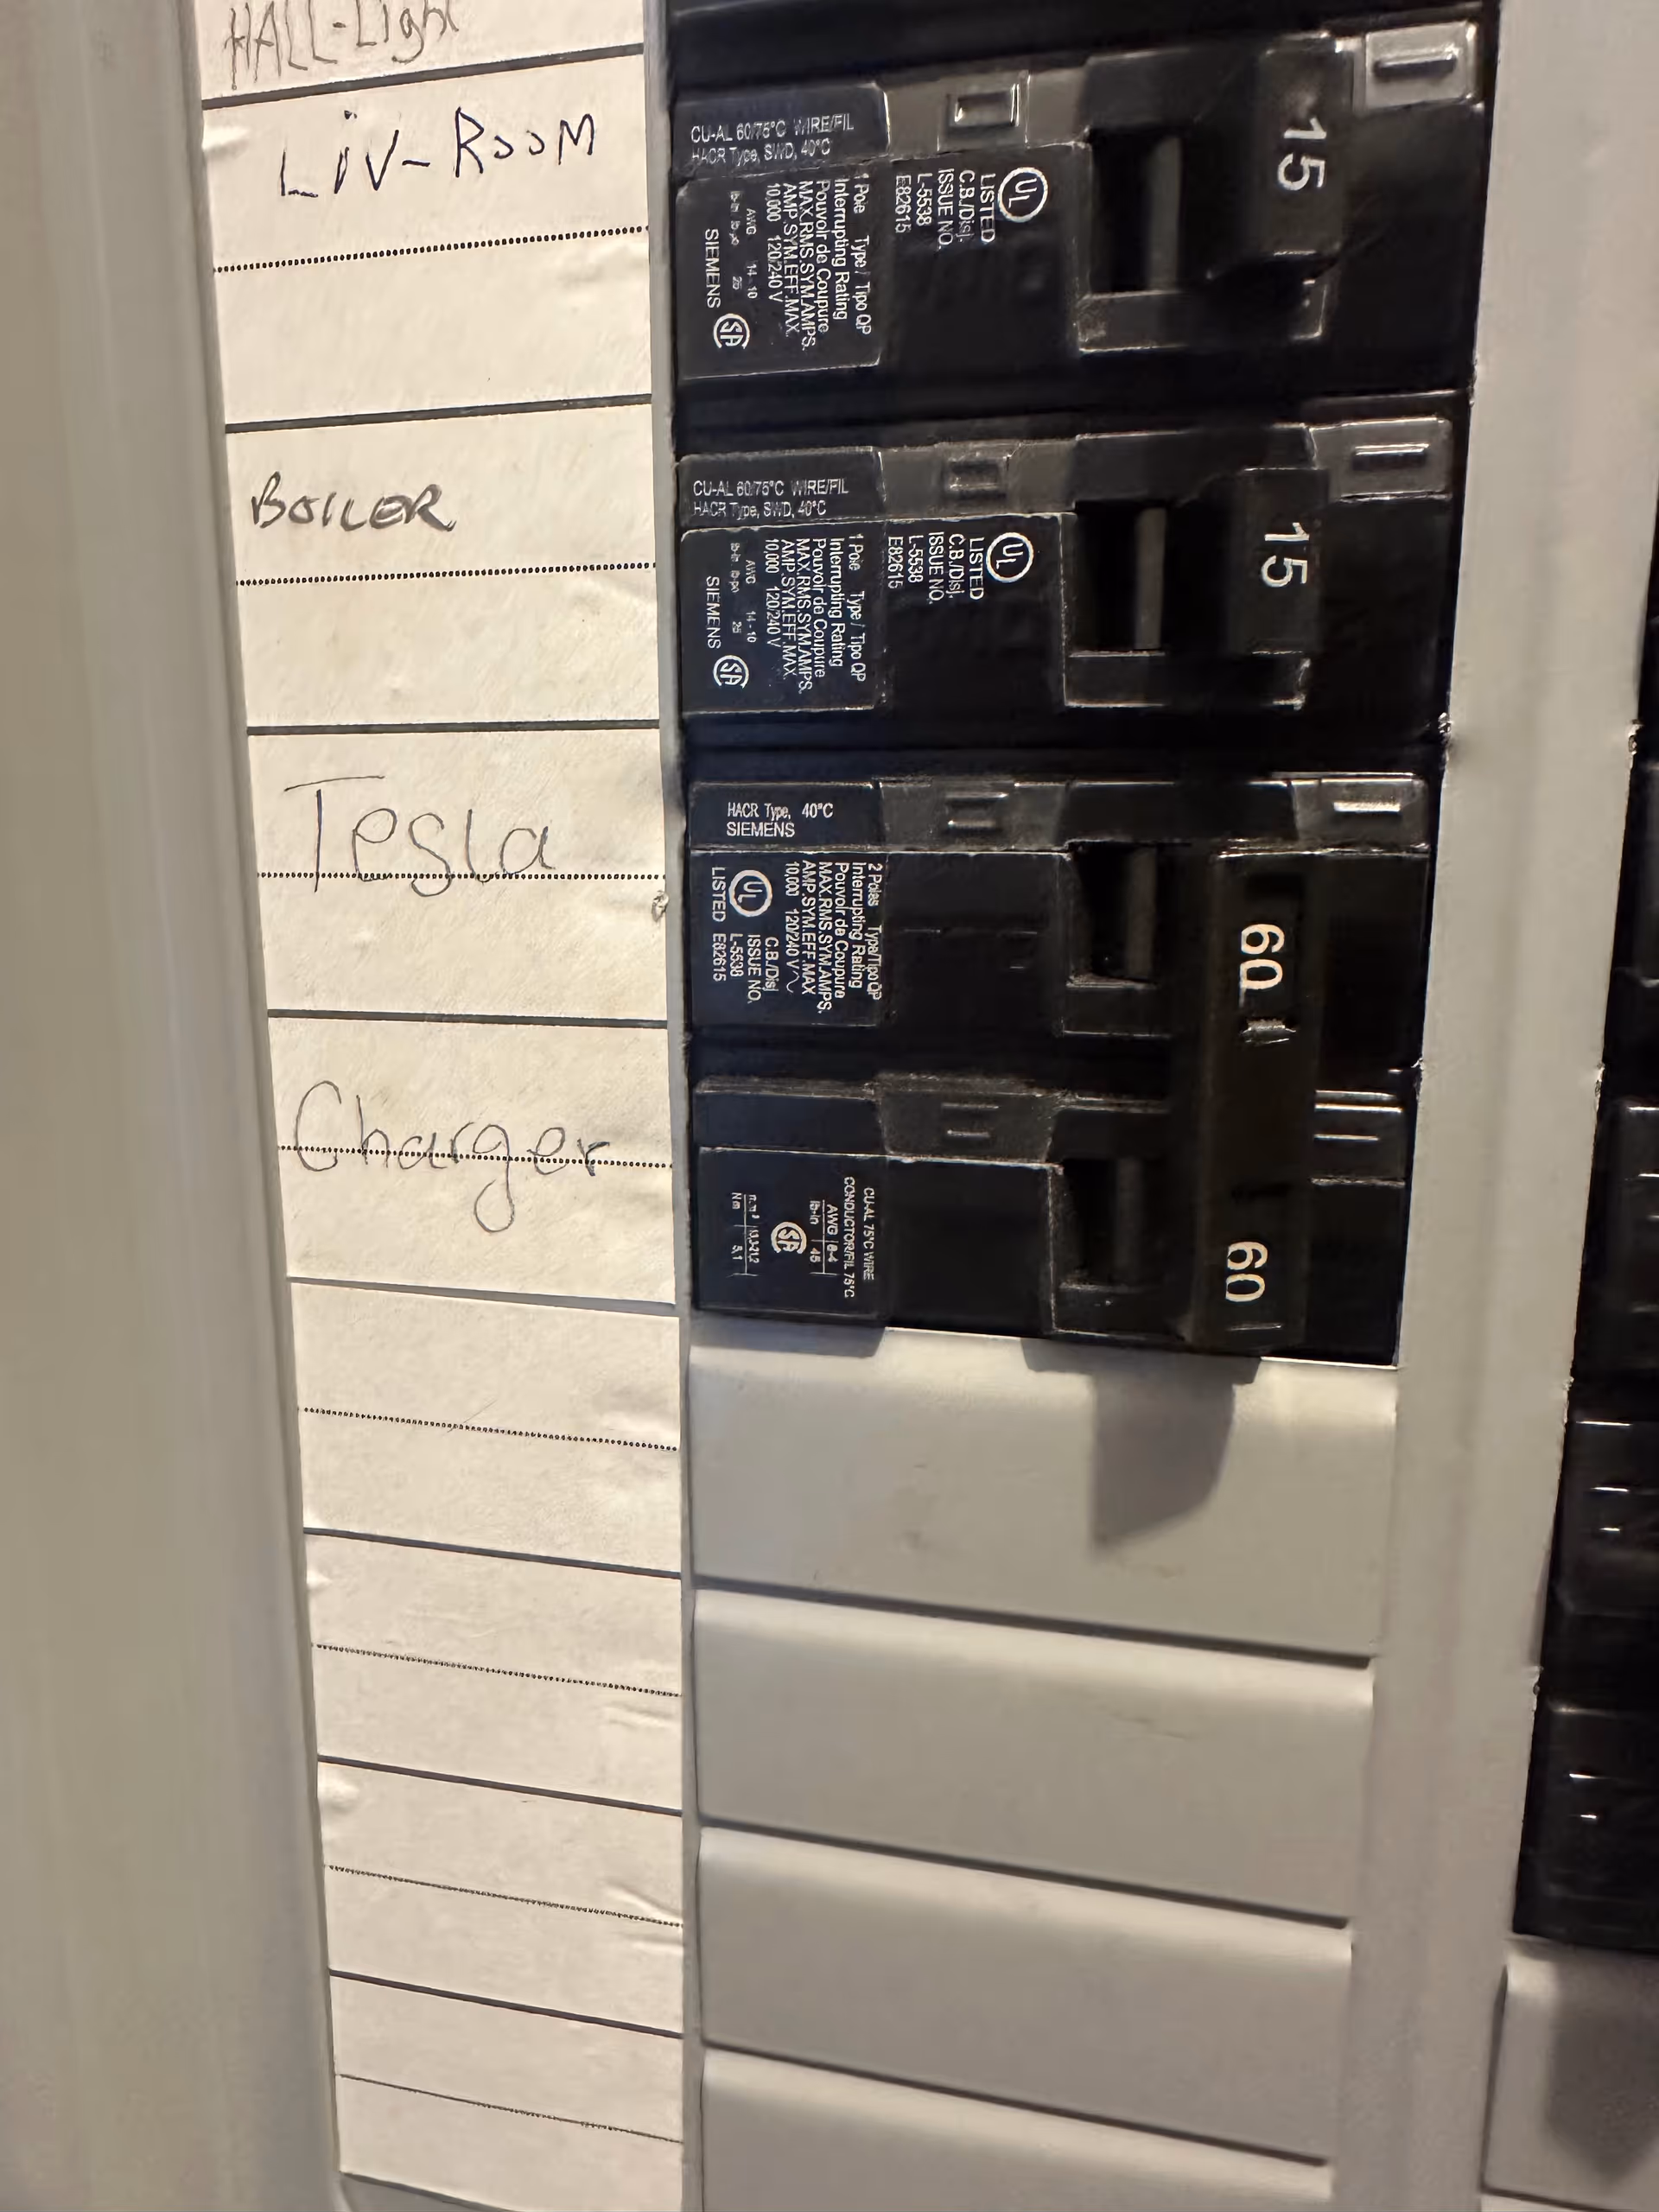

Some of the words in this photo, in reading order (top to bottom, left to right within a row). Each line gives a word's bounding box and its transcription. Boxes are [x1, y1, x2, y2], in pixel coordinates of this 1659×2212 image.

[690, 124, 733, 143] CU-AL
[794, 113, 854, 136] WIRE/FIL
[1277, 117, 1327, 191] 15
[765, 183, 781, 222] 10,000
[816, 179, 830, 240] Pouvoir
[895, 175, 912, 233] E82615
[916, 173, 933, 226] L-5538
[938, 168, 955, 216] ISSUE
[980, 173, 996, 243] LISTED
[831, 178, 849, 268] Interrupting
[938, 220, 954, 250] NO.
[705, 228, 721, 308] SIEMENS
[817, 244, 831, 264] de
[850, 235, 869, 268] Type
[768, 291, 784, 302] V
[813, 268, 831, 334] Coupure
[832, 271, 849, 320] Rating
[693, 480, 734, 497] CU-AL
[791, 478, 849, 496] WIRE/FIL
[693, 501, 727, 517] HACR
[798, 499, 827, 517] 40°C
[763, 538, 779, 574] 10,000
[812, 537, 827, 594] Pouvoir
[887, 536, 904, 589] E82615
[908, 535, 924, 583] L-5538
[929, 531, 944, 575] ISSUE
[969, 537, 985, 600] LISTED
[1261, 522, 1310, 588] 15
[827, 537, 845, 619] Interrupting
[928, 579, 944, 605] NO.
[706, 576, 721, 650] SIEMENS
[766, 585, 781, 635] 120/240
[813, 597, 827, 616] de
[847, 590, 865, 620] Type
[766, 638, 782, 648] V
[810, 619, 828, 678] Coupure
[829, 622, 845, 667] Rating
[847, 632, 866, 661] Tipo
[850, 662, 867, 682] QP
[726, 821, 795, 837] SIEMENS
[727, 802, 759, 817] HACR
[764, 803, 791, 821] Type,
[802, 802, 834, 818] 40°C
[283, 775, 556, 898] Tesla
[785, 861, 799, 897] 10,000
[834, 862, 849, 916] Pouvoir
[868, 862, 883, 871] 2
[868, 874, 882, 906] Poles
[711, 867, 726, 922] LISTED
[849, 862, 867, 940] Interrupting
[785, 908, 799, 957] 120/240
[835, 918, 849, 937] de
[713, 933, 727, 982] E82615
[747, 934, 761, 976] ISSUE
[786, 959, 799, 969] V
[831, 940, 849, 999] Coupure
[849, 944, 865, 988] Rating
[1239, 923, 1286, 991] 60
[295, 1080, 610, 1233] Charger
[827, 1204, 838, 1236] AWG
[863, 1251, 874, 1281] WIRE
[1224, 1241, 1268, 1303] 60
